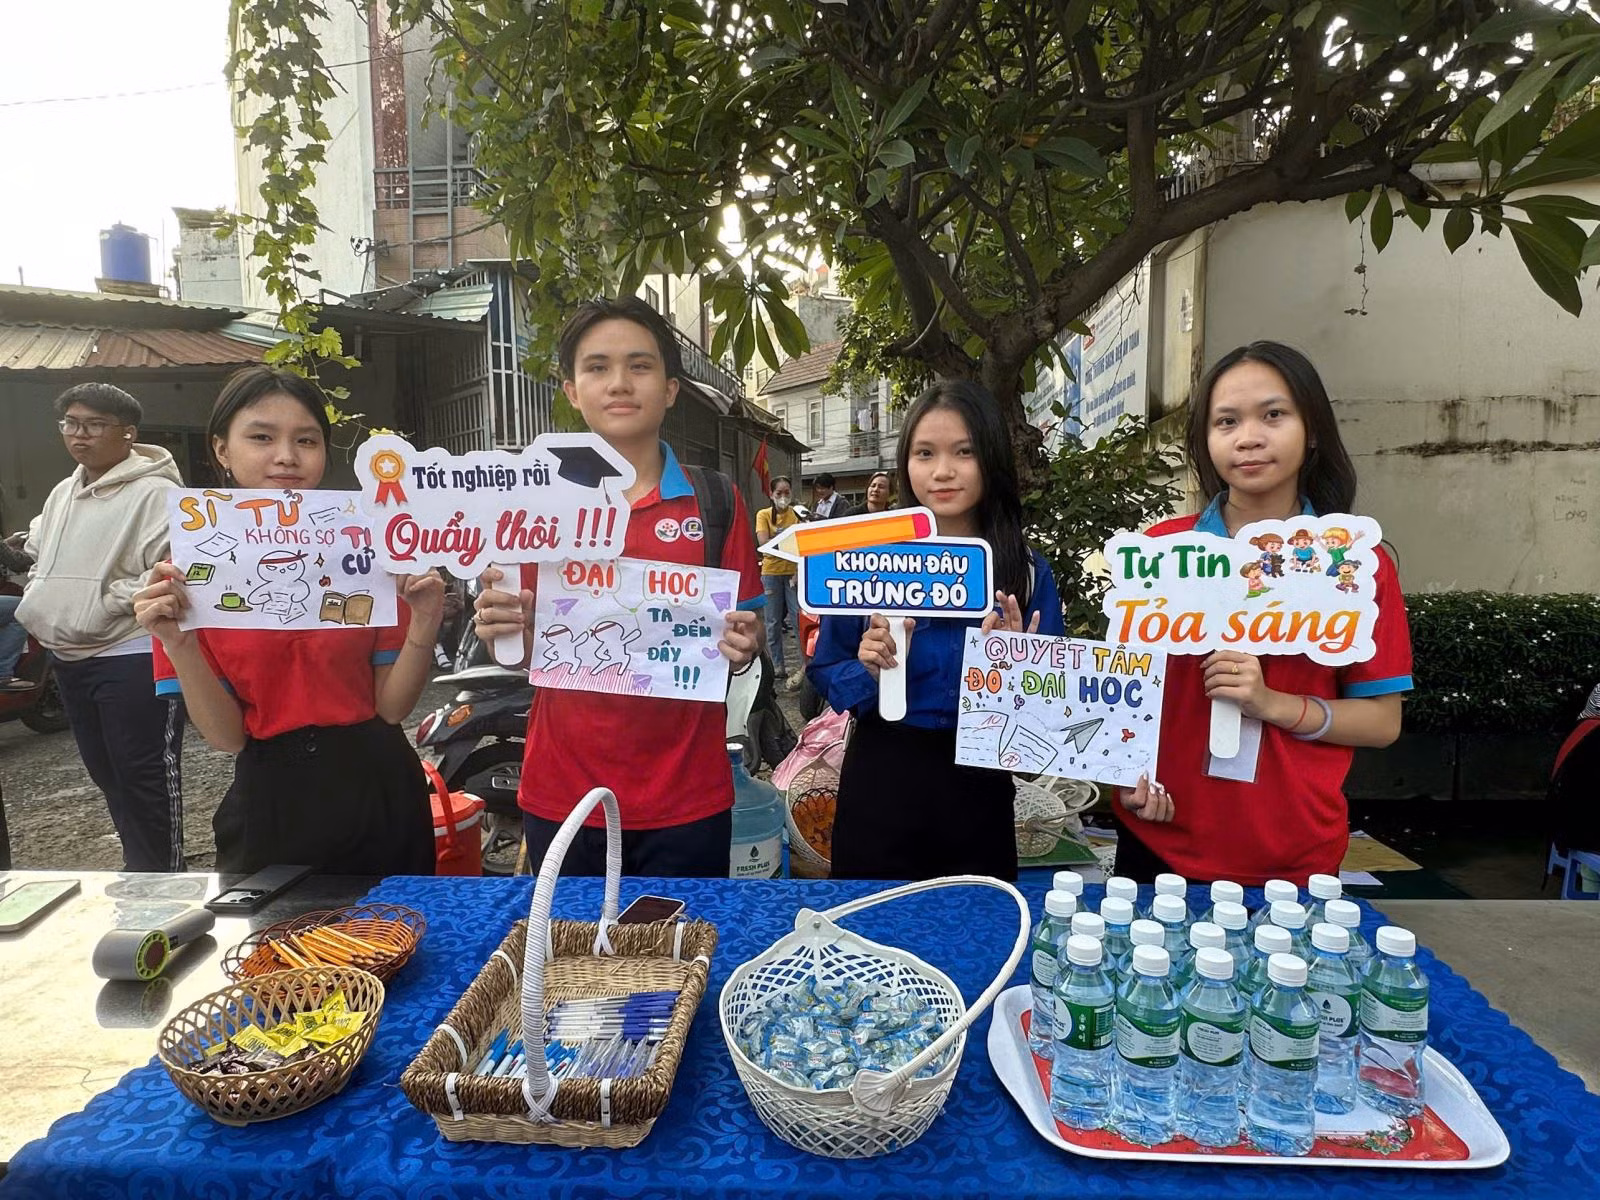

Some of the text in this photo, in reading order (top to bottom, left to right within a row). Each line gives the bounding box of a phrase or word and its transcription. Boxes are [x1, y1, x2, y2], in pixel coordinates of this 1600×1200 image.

[412, 459, 550, 492] Tốt nghiệp rồi
[179, 489, 303, 531] SĨ TỬ
[245, 524, 310, 545] KHÔNG
[316, 527, 335, 548] SỢ
[385, 511, 487, 566] Quẩy
[496, 509, 561, 551] thôi
[574, 507, 617, 548] !!!
[342, 546, 376, 575] CỬ
[835, 550, 968, 575] KHOANH ĐÂU
[1117, 544, 1231, 589] Tự Tin
[563, 559, 698, 603] ĐẠI HỌC
[826, 575, 968, 607] TRÚNG ĐÓ
[648, 607, 673, 623] TA
[672, 616, 712, 638] ĐẾN
[1116, 597, 1362, 654] Tỏa sáng
[647, 640, 681, 662] ĐÂY
[985, 636, 1152, 677] QUYẾT TÂM
[673, 665, 701, 690] !!!
[964, 661, 1012, 694] ĐỖ
[1021, 670, 1066, 704] ĐẠI
